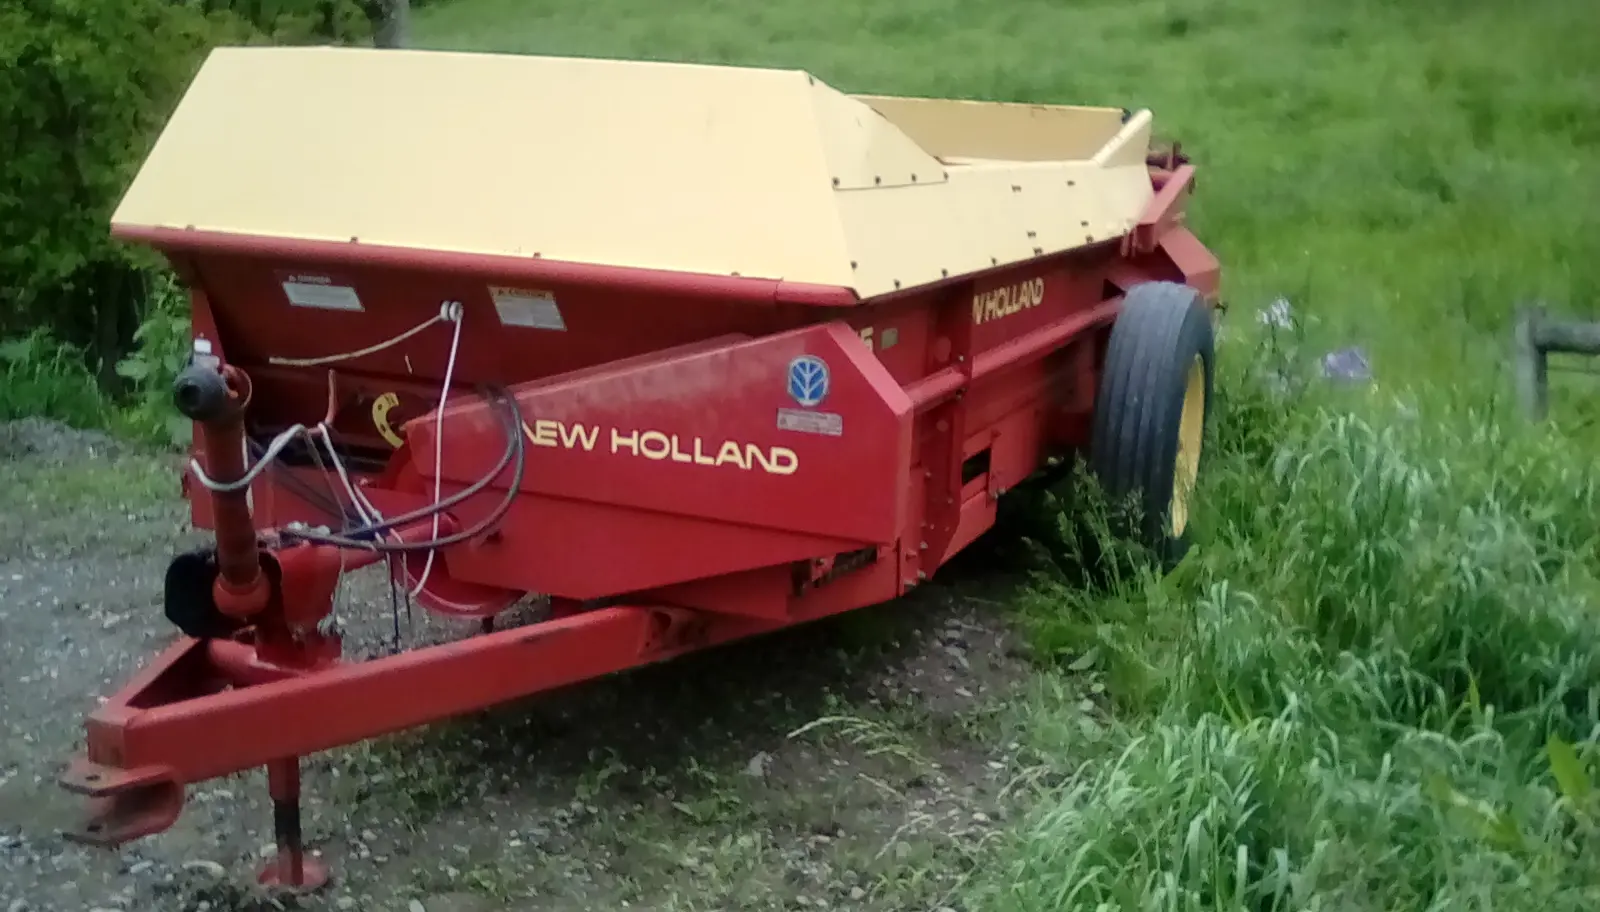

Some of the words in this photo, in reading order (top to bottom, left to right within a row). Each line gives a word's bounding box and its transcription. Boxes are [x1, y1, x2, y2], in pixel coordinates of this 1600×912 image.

[985, 276, 1044, 322] HOLLAND
[521, 419, 600, 451] NEW
[611, 427, 798, 475] HOLLAND
